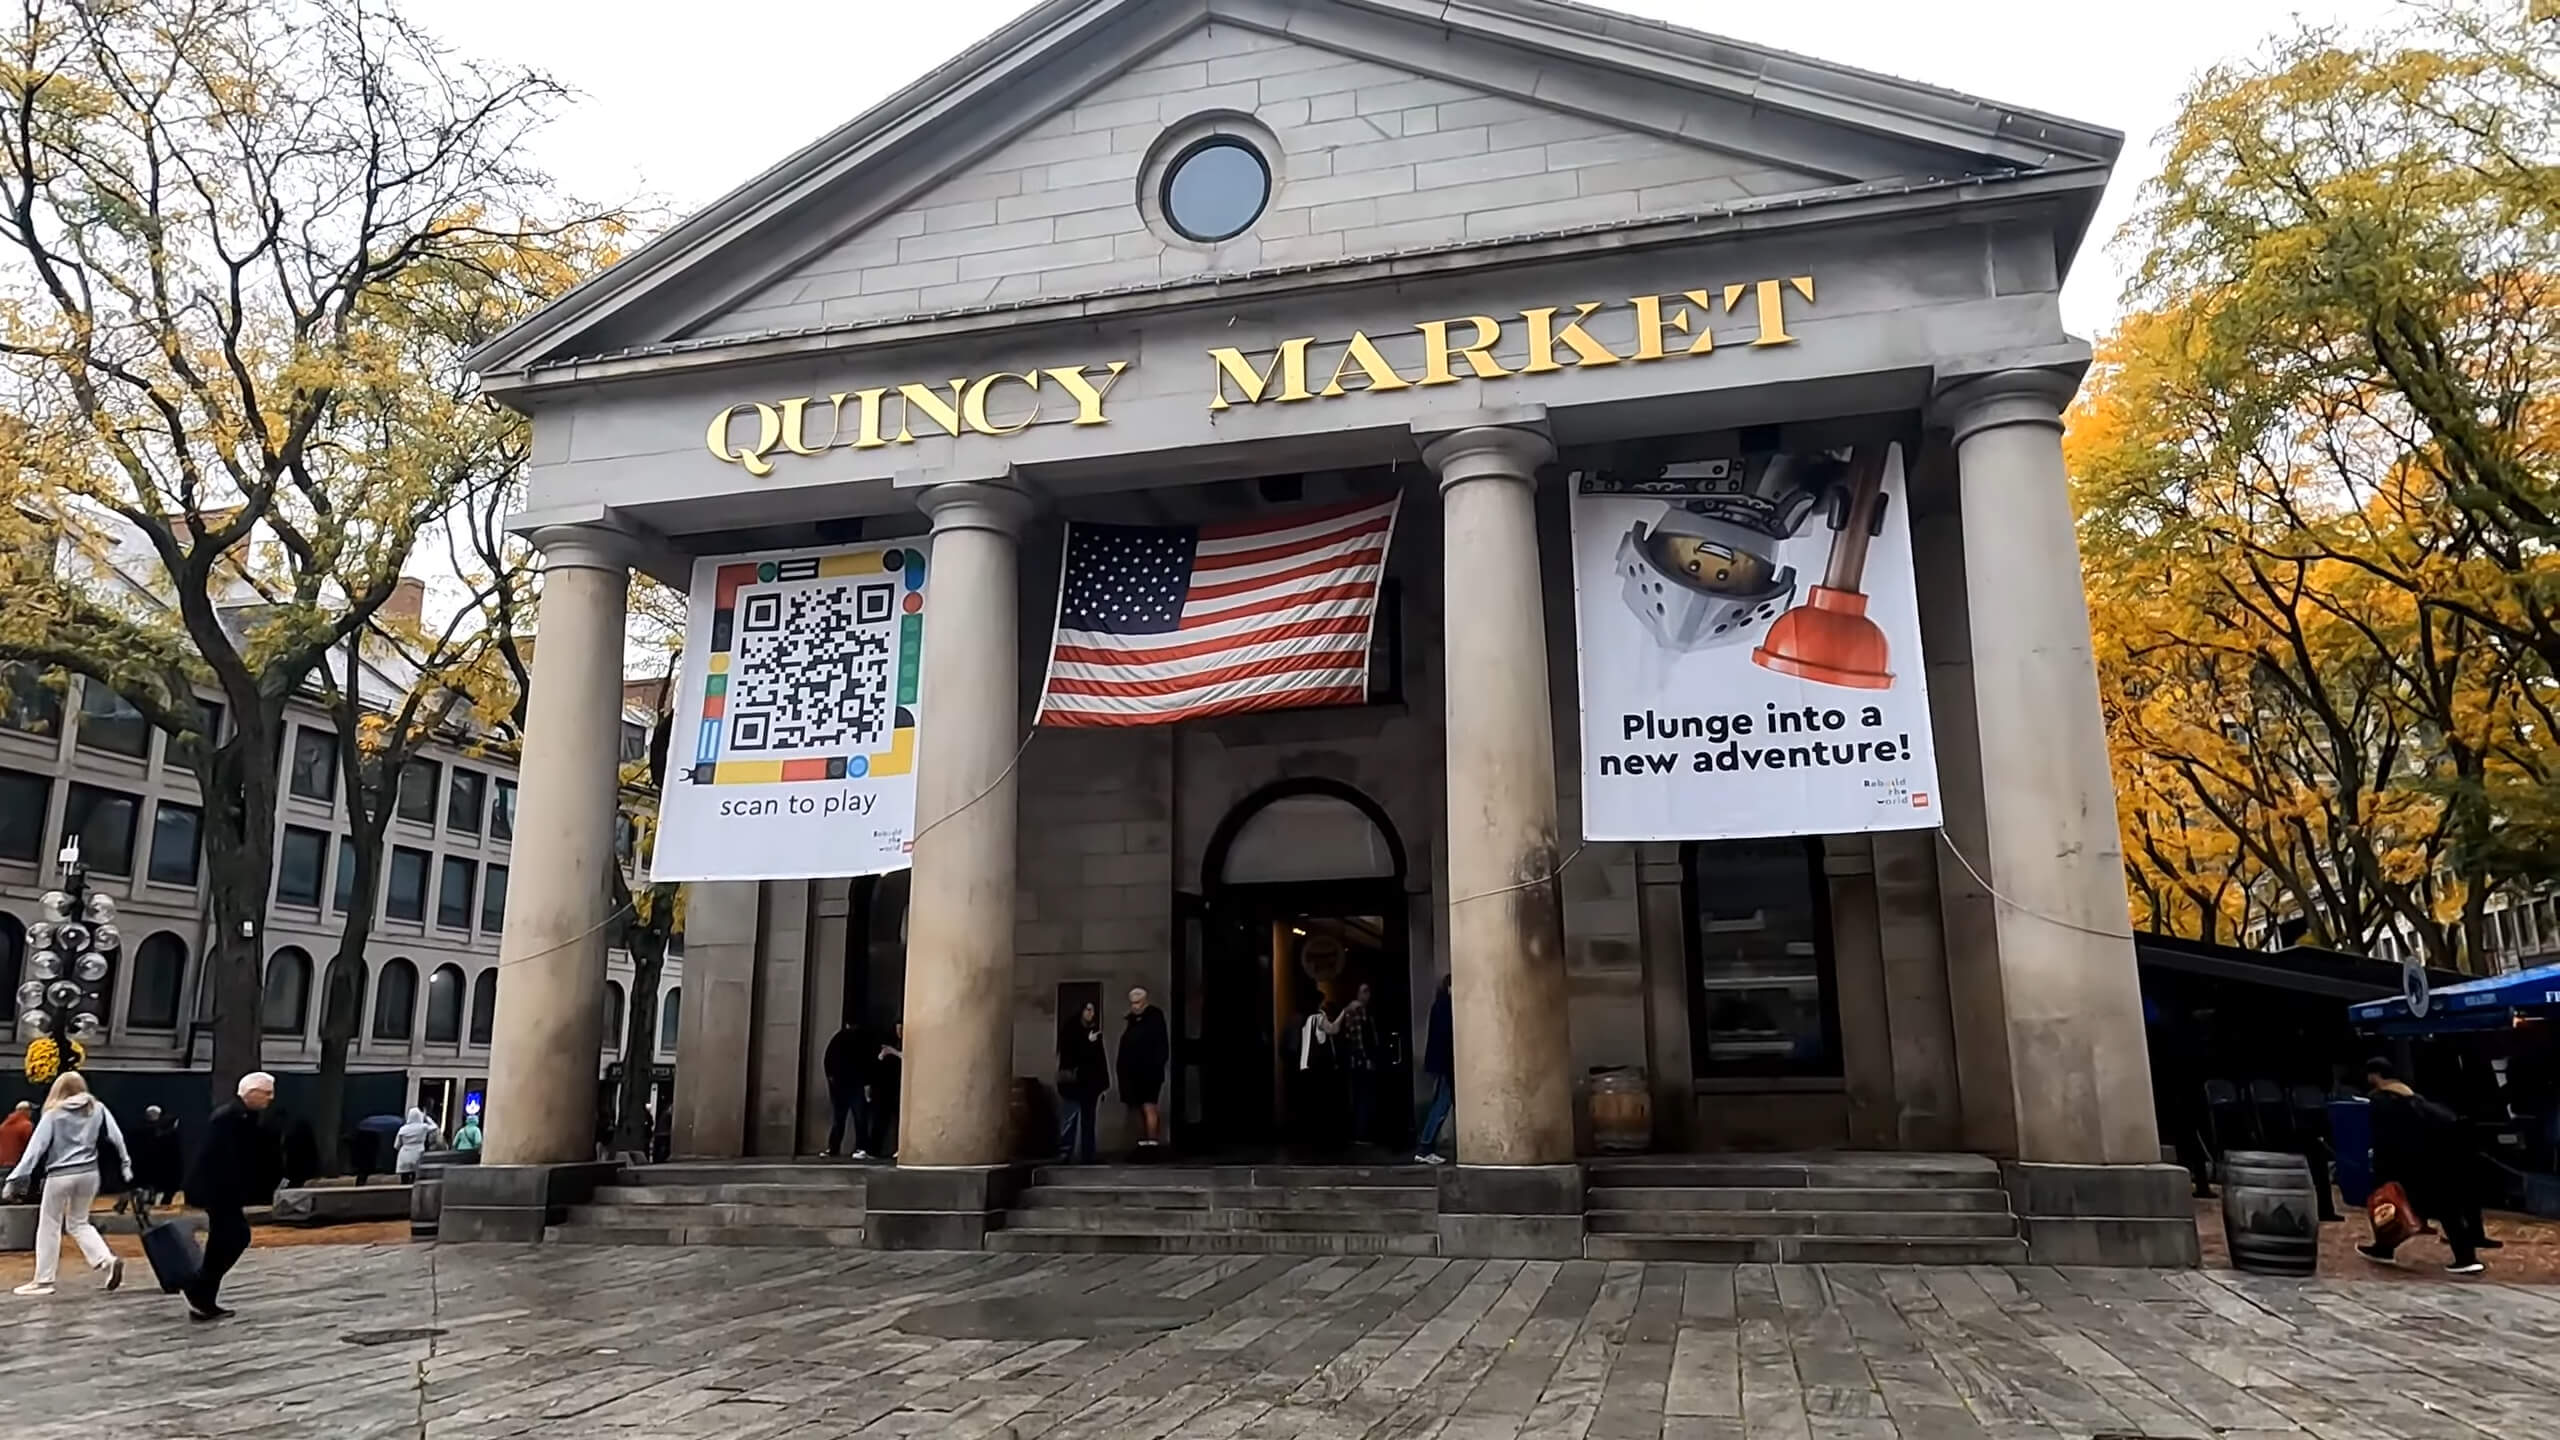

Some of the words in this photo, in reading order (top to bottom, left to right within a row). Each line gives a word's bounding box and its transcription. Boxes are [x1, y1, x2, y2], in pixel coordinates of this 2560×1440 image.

[706, 361, 1129, 476] QUINCY
[1208, 276, 1815, 409] MARKET
[1623, 710, 1754, 744] Plunge
[1766, 702, 1845, 733] into
[1860, 706, 1882, 727] a
[1600, 753, 1679, 776] new
[1692, 734, 1911, 774] adventure!
[720, 800, 778, 816] scan
[788, 795, 815, 814] to
[823, 788, 877, 817] play
[1863, 779, 1907, 788] Rebild
